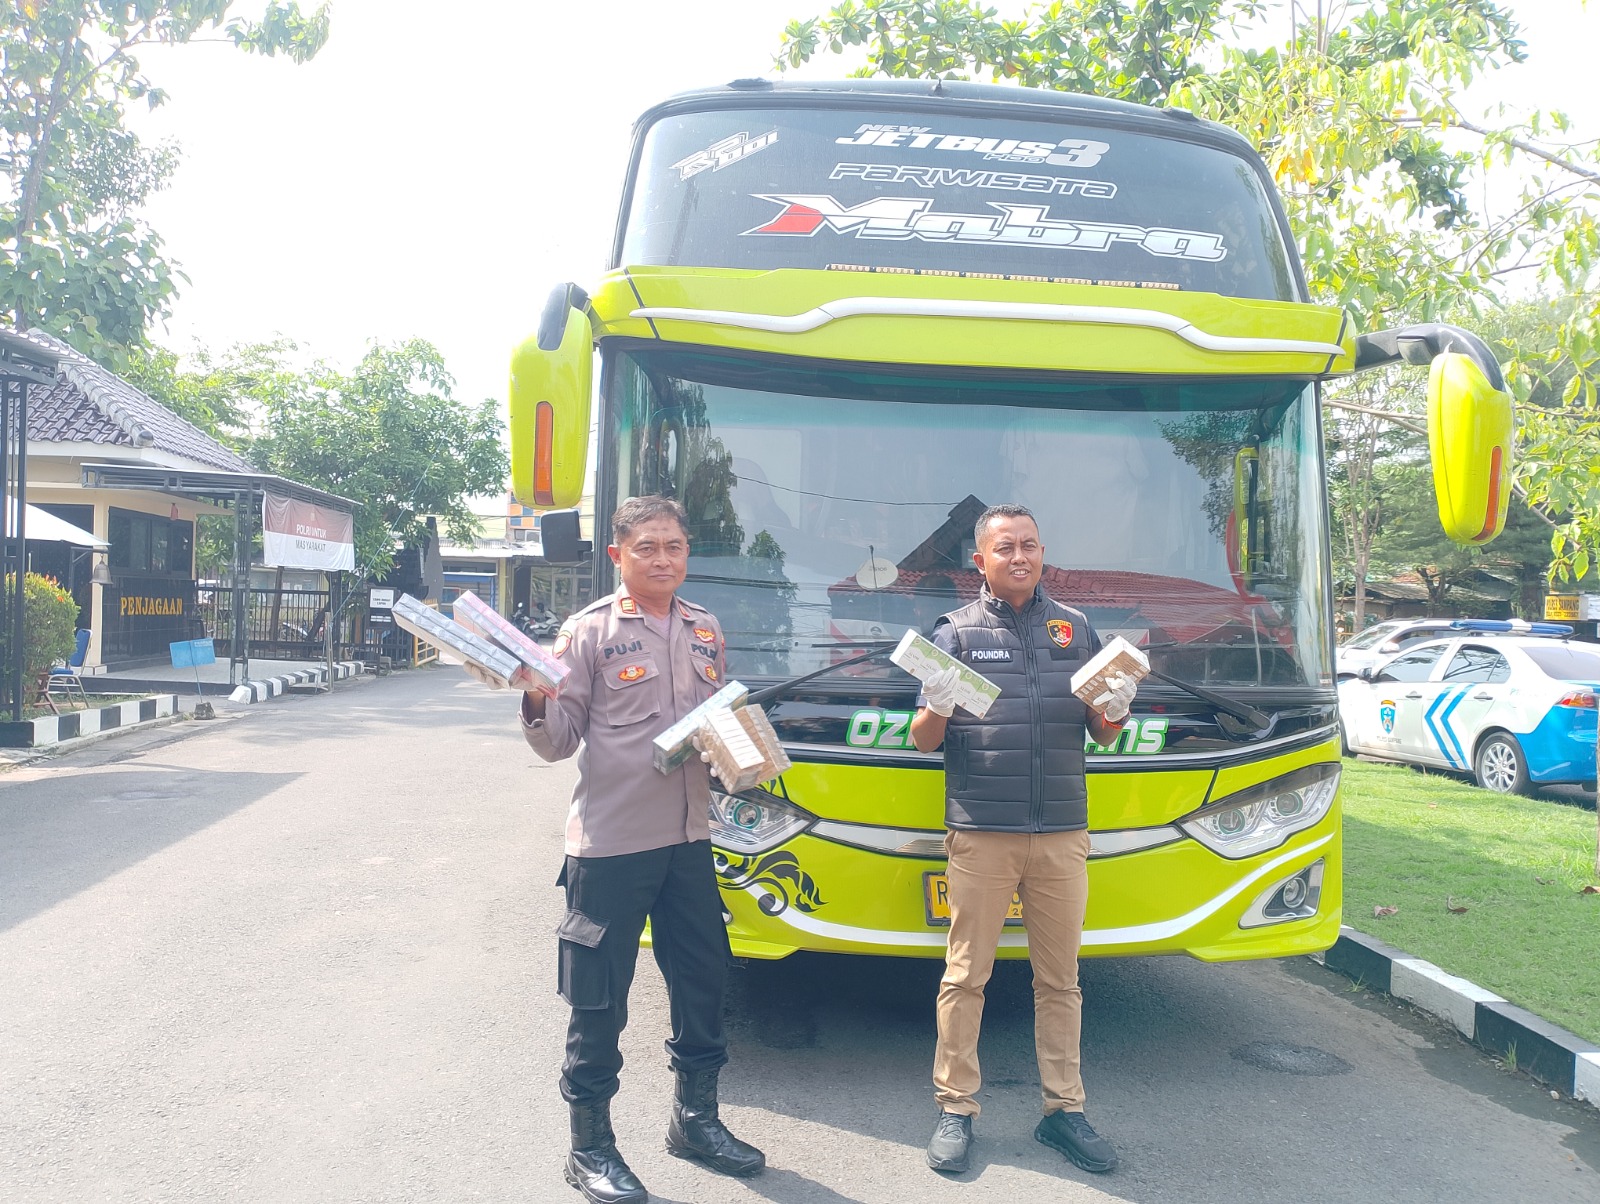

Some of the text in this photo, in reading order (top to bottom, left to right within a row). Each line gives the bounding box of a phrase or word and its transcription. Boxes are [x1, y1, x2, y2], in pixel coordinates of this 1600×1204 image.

[854, 124, 932, 135] NEW
[738, 194, 1228, 262] Mabra
[296, 524, 311, 536] POLRI
[295, 540, 326, 552] MASYARAKAT
[120, 596, 182, 616] PENJAGAAN
[604, 641, 642, 659] PUJI
[972, 650, 1010, 660] POUNDRA
